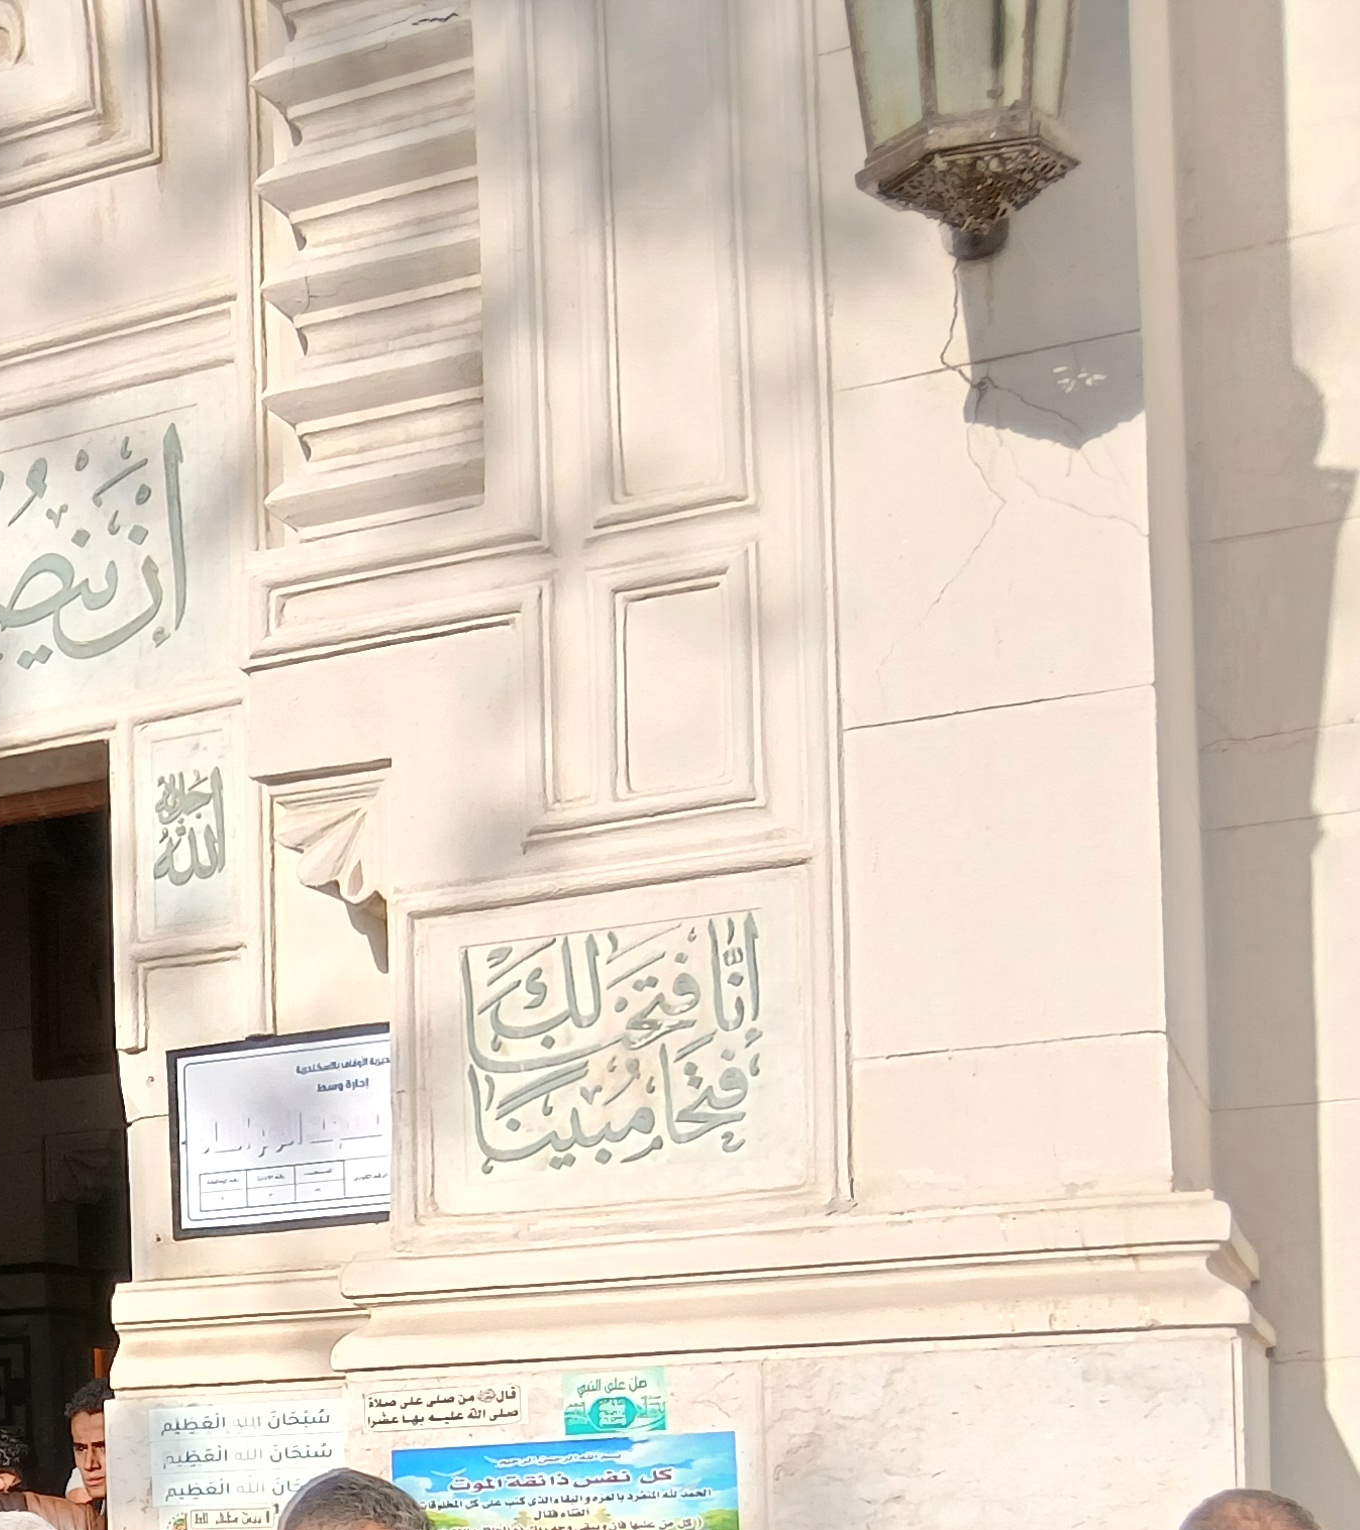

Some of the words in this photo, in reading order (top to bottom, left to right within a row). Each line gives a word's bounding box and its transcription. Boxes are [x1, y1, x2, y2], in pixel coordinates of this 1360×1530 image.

[426, 1395, 455, 1407] صلى
[458, 1394, 475, 1405] من
[496, 1386, 516, 1403] قال
[402, 1414, 425, 1426] بها
[467, 1408, 486, 1419] الله
[489, 1408, 519, 1421] صلى
[573, 1471, 631, 1487] نفس
[640, 1469, 673, 1484] كل
[449, 1478, 502, 1492] الموت
